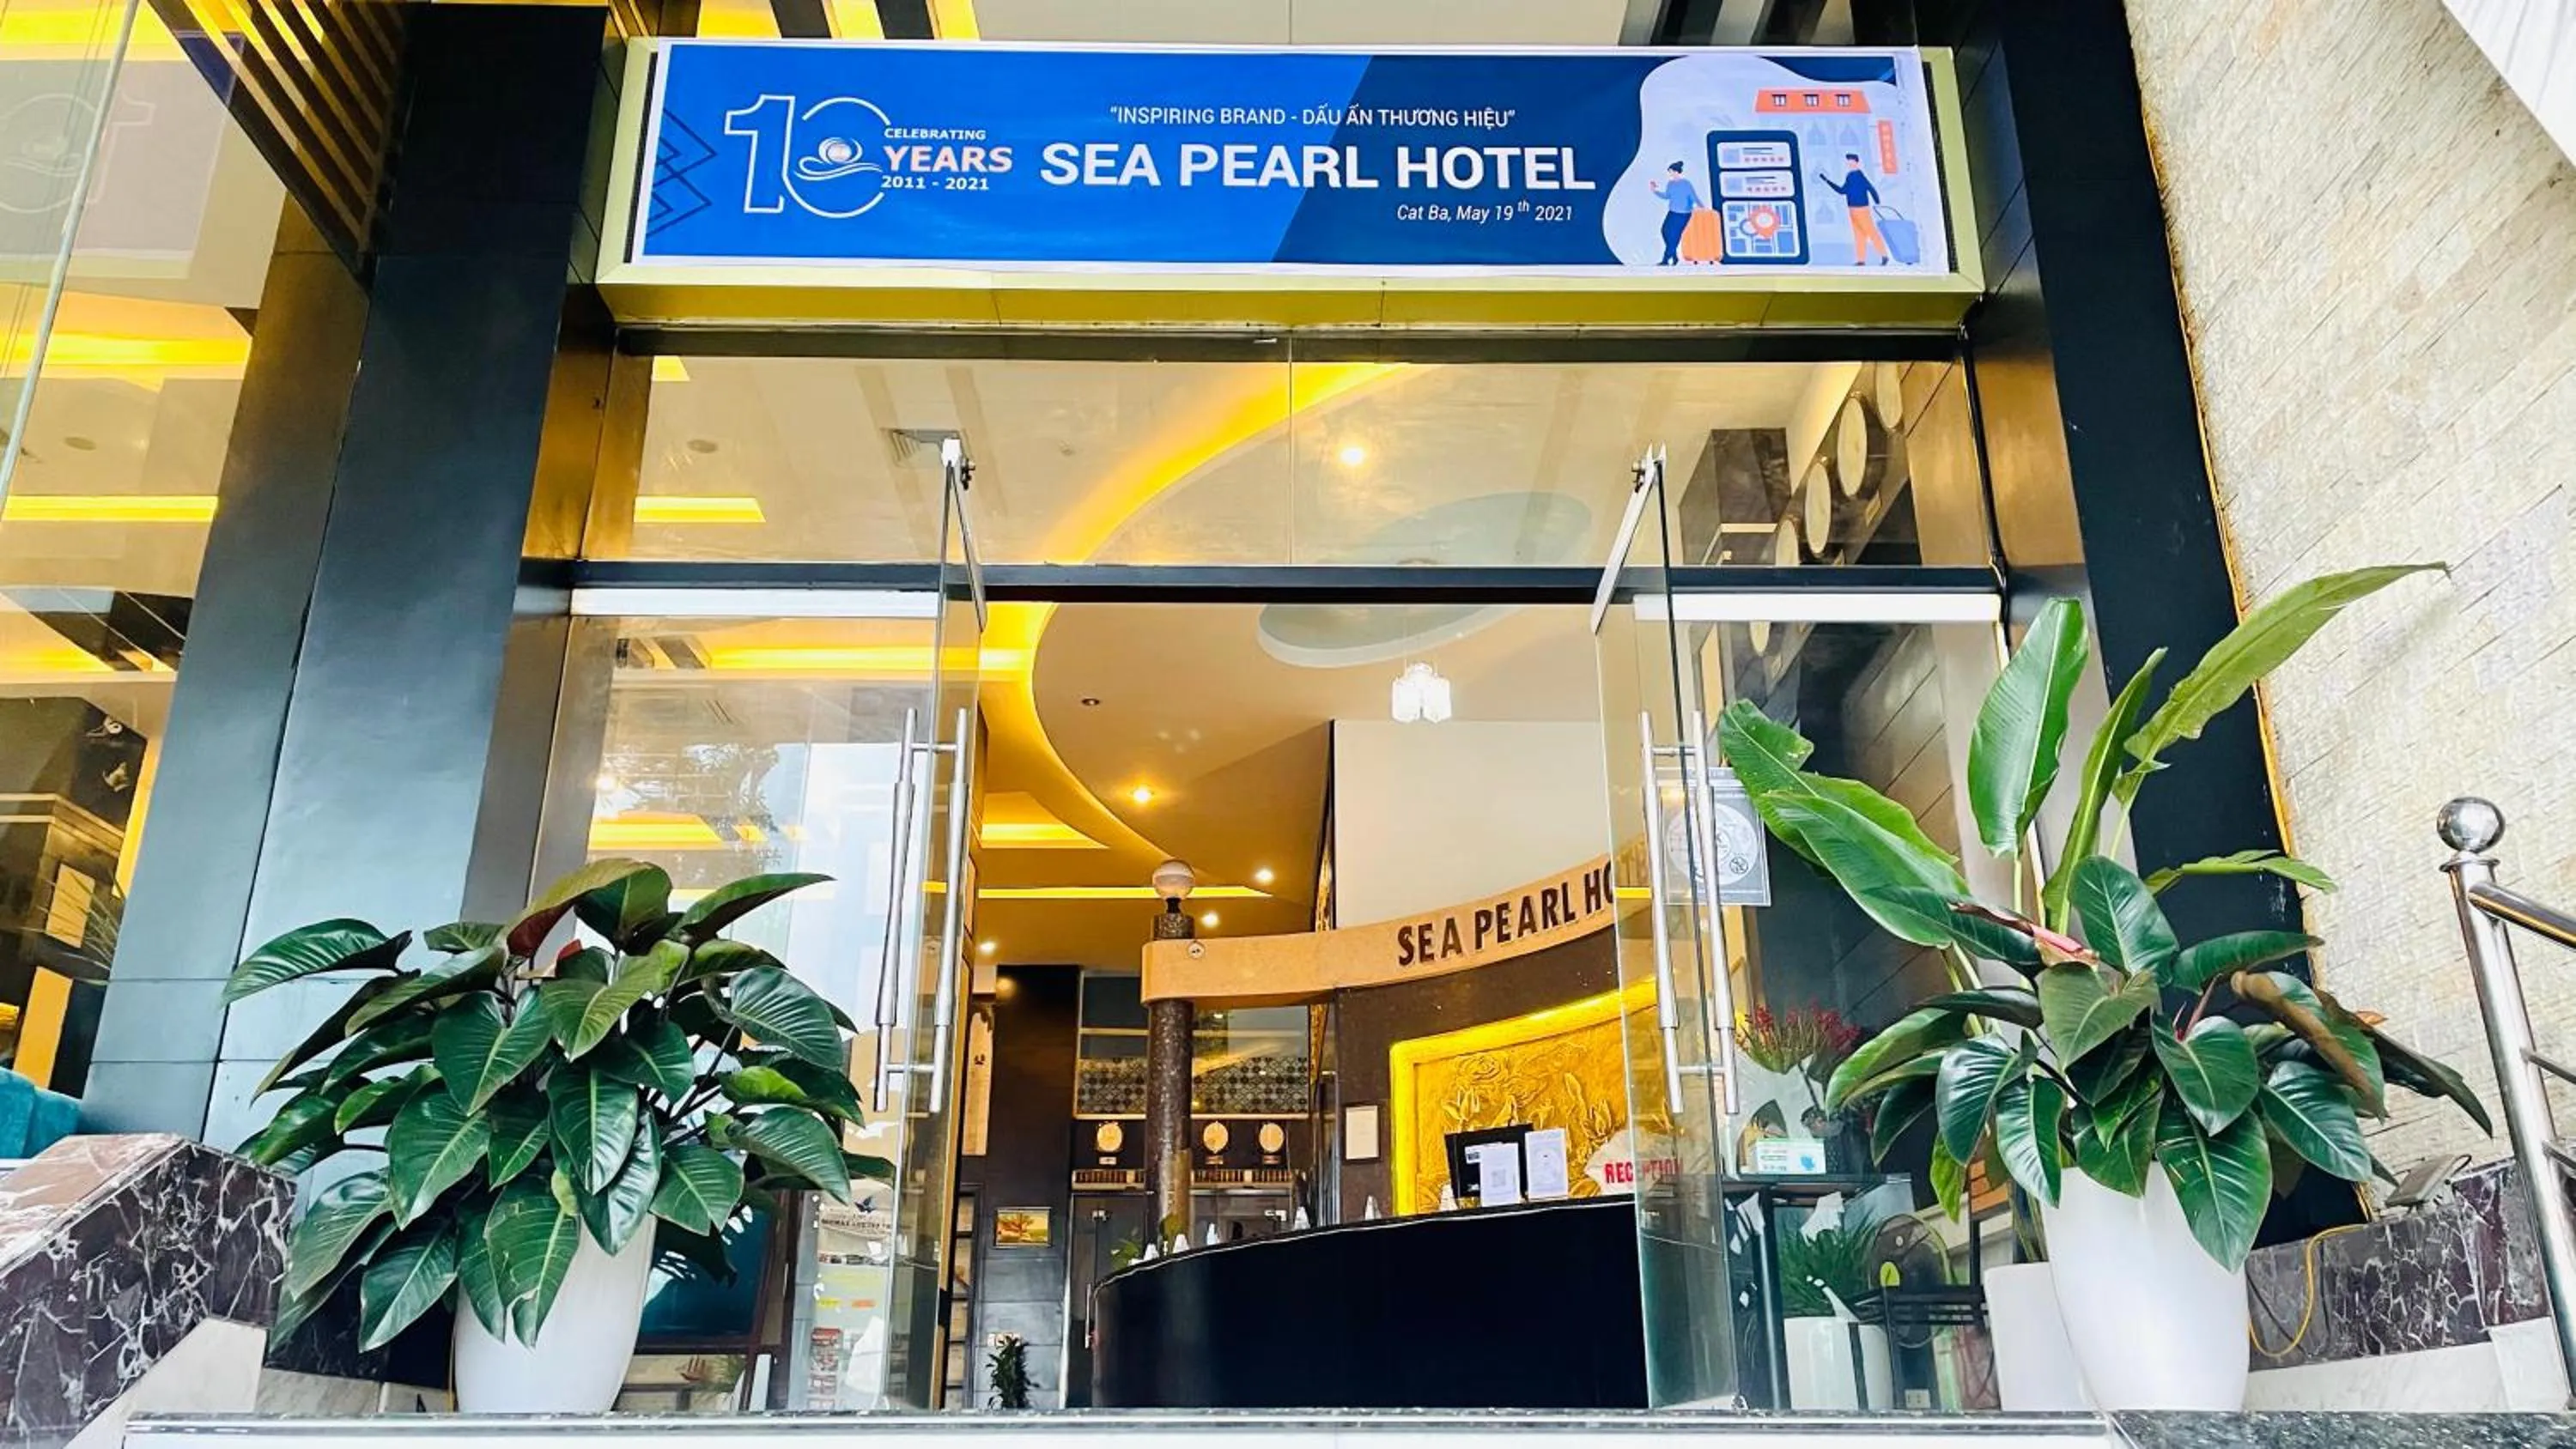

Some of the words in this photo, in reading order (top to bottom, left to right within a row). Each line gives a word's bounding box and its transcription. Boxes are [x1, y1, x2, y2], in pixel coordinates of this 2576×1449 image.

[1219, 108, 1286, 125] BRAND
[1302, 102, 1341, 125] DẤU
[1346, 102, 1373, 125] ẤN
[1377, 108, 1459, 127] THƯƠNG
[883, 127, 987, 141] CELEBRATING
[882, 145, 1014, 173] YEARS
[1039, 142, 1162, 187] SEA
[1179, 143, 1380, 188] PEARL
[1396, 146, 1597, 190] HOTEL
[880, 174, 927, 190] 2011
[944, 177, 990, 191] 2021
[1396, 204, 1424, 221] Cat
[1427, 204, 1452, 223] Ba,
[1455, 204, 1490, 225] May
[1494, 205, 1514, 221] 19
[1534, 205, 1573, 221] 2021
[1397, 917, 1464, 967] SEA
[1473, 882, 1577, 951] PEARL
[1603, 1157, 1683, 1184] RECPTION
